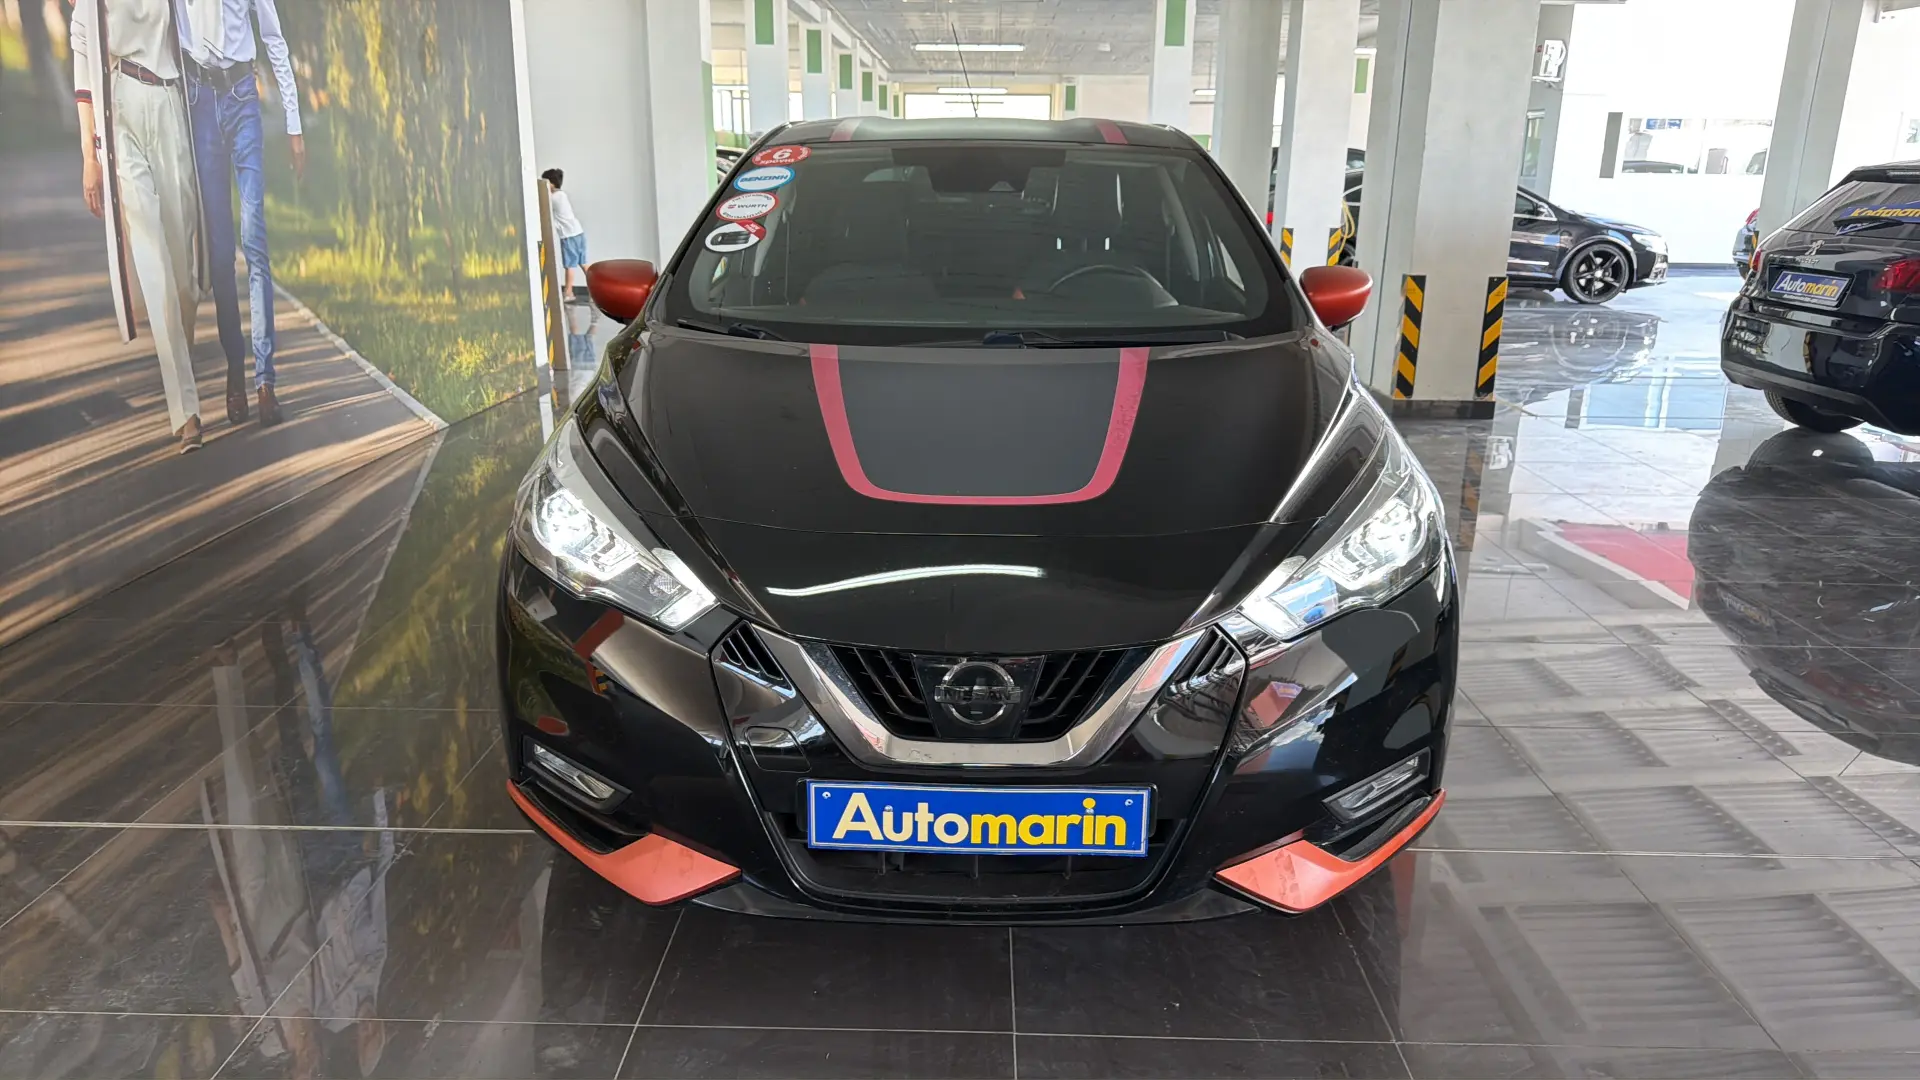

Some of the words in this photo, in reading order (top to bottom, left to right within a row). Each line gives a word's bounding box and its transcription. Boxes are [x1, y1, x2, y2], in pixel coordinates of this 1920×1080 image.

[772, 148, 793, 160] 6
[1776, 274, 1839, 297] Automarin
[940, 686, 1016, 702] NISSAN
[831, 792, 1127, 847] Automarin
